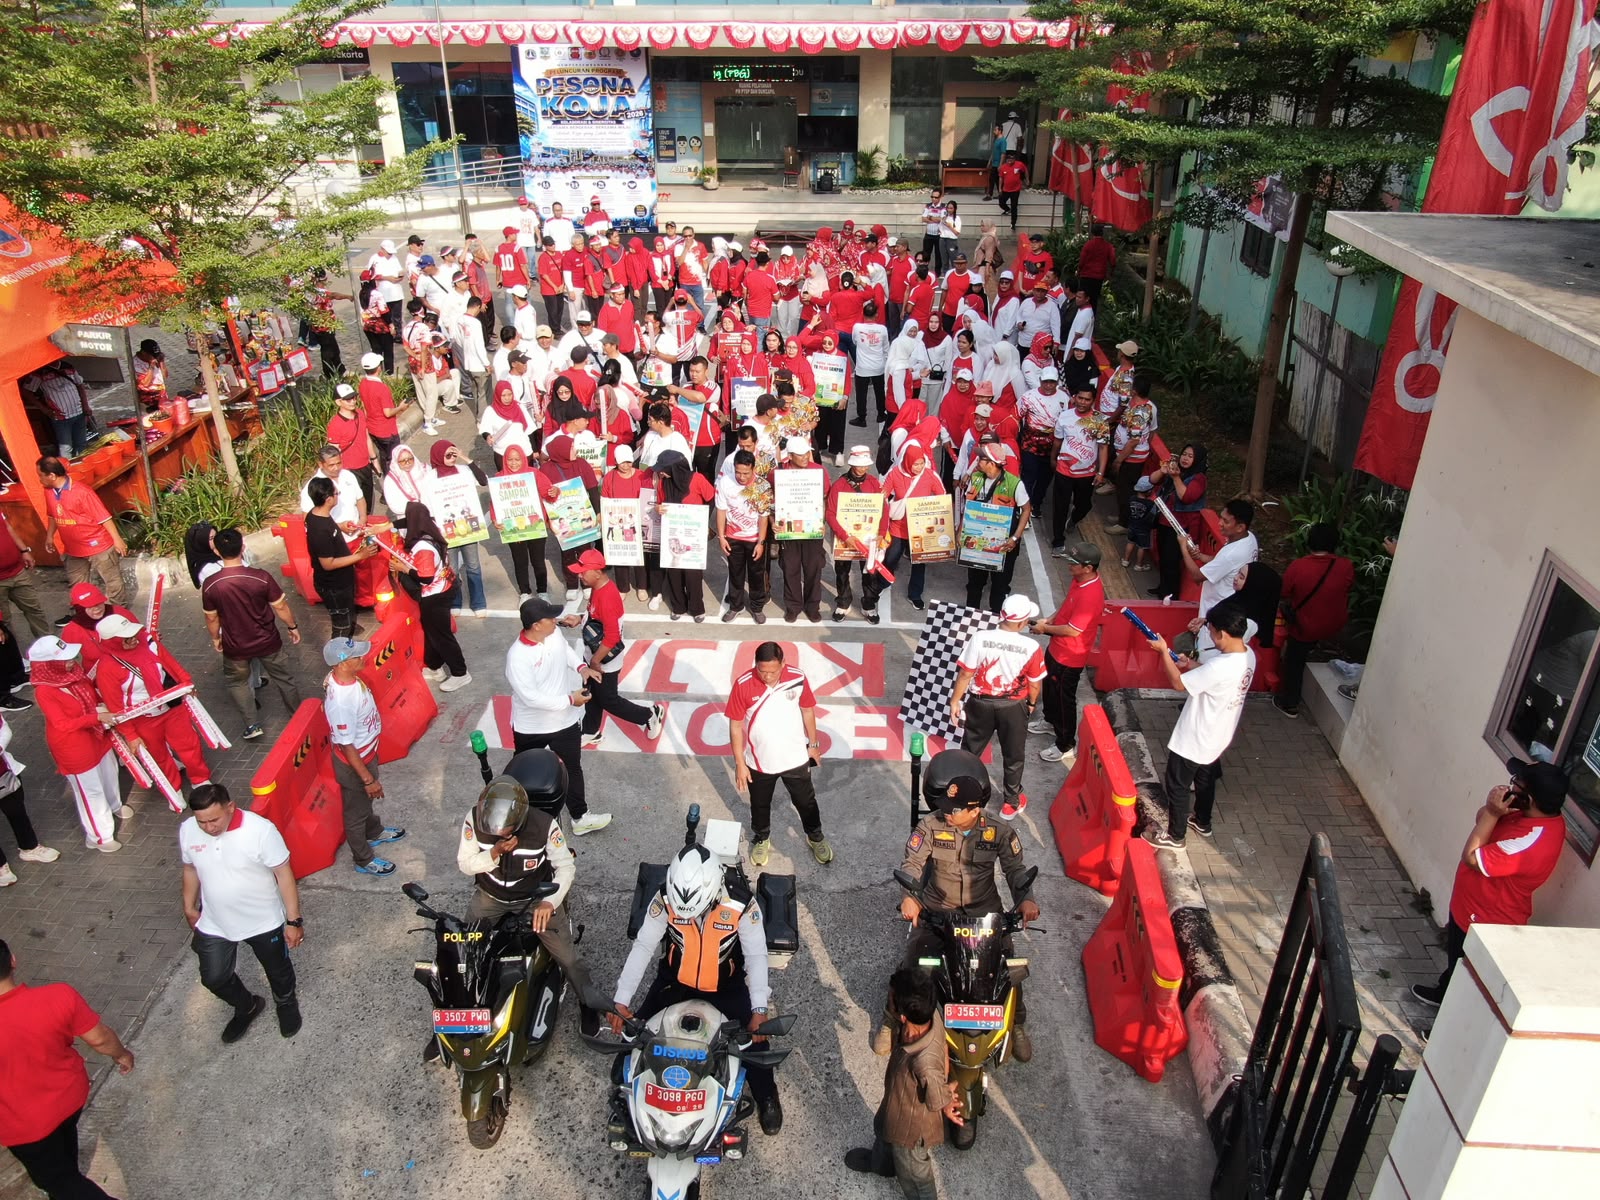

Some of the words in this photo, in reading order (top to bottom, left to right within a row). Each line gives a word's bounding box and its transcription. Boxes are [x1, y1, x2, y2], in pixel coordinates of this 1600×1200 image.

[535, 76, 636, 96] PESONA
[540, 95, 632, 119] KOJA
[500, 254, 514, 271] 10
[78, 330, 112, 340] PARKIR
[80, 341, 112, 352] MOTOR
[499, 487, 530, 502] SAMPAH
[982, 640, 1028, 656] INDONESIA
[444, 933, 465, 942] POL
[468, 932, 482, 941] PP
[954, 928, 976, 937] POL
[979, 929, 993, 938] PP
[434, 1012, 440, 1021] B
[445, 1012, 466, 1022] 3502
[946, 1006, 952, 1016] B
[957, 1006, 980, 1017] 3563
[652, 1044, 708, 1061] DISHUB
[647, 1085, 653, 1095] B
[657, 1090, 681, 1102] 3098
